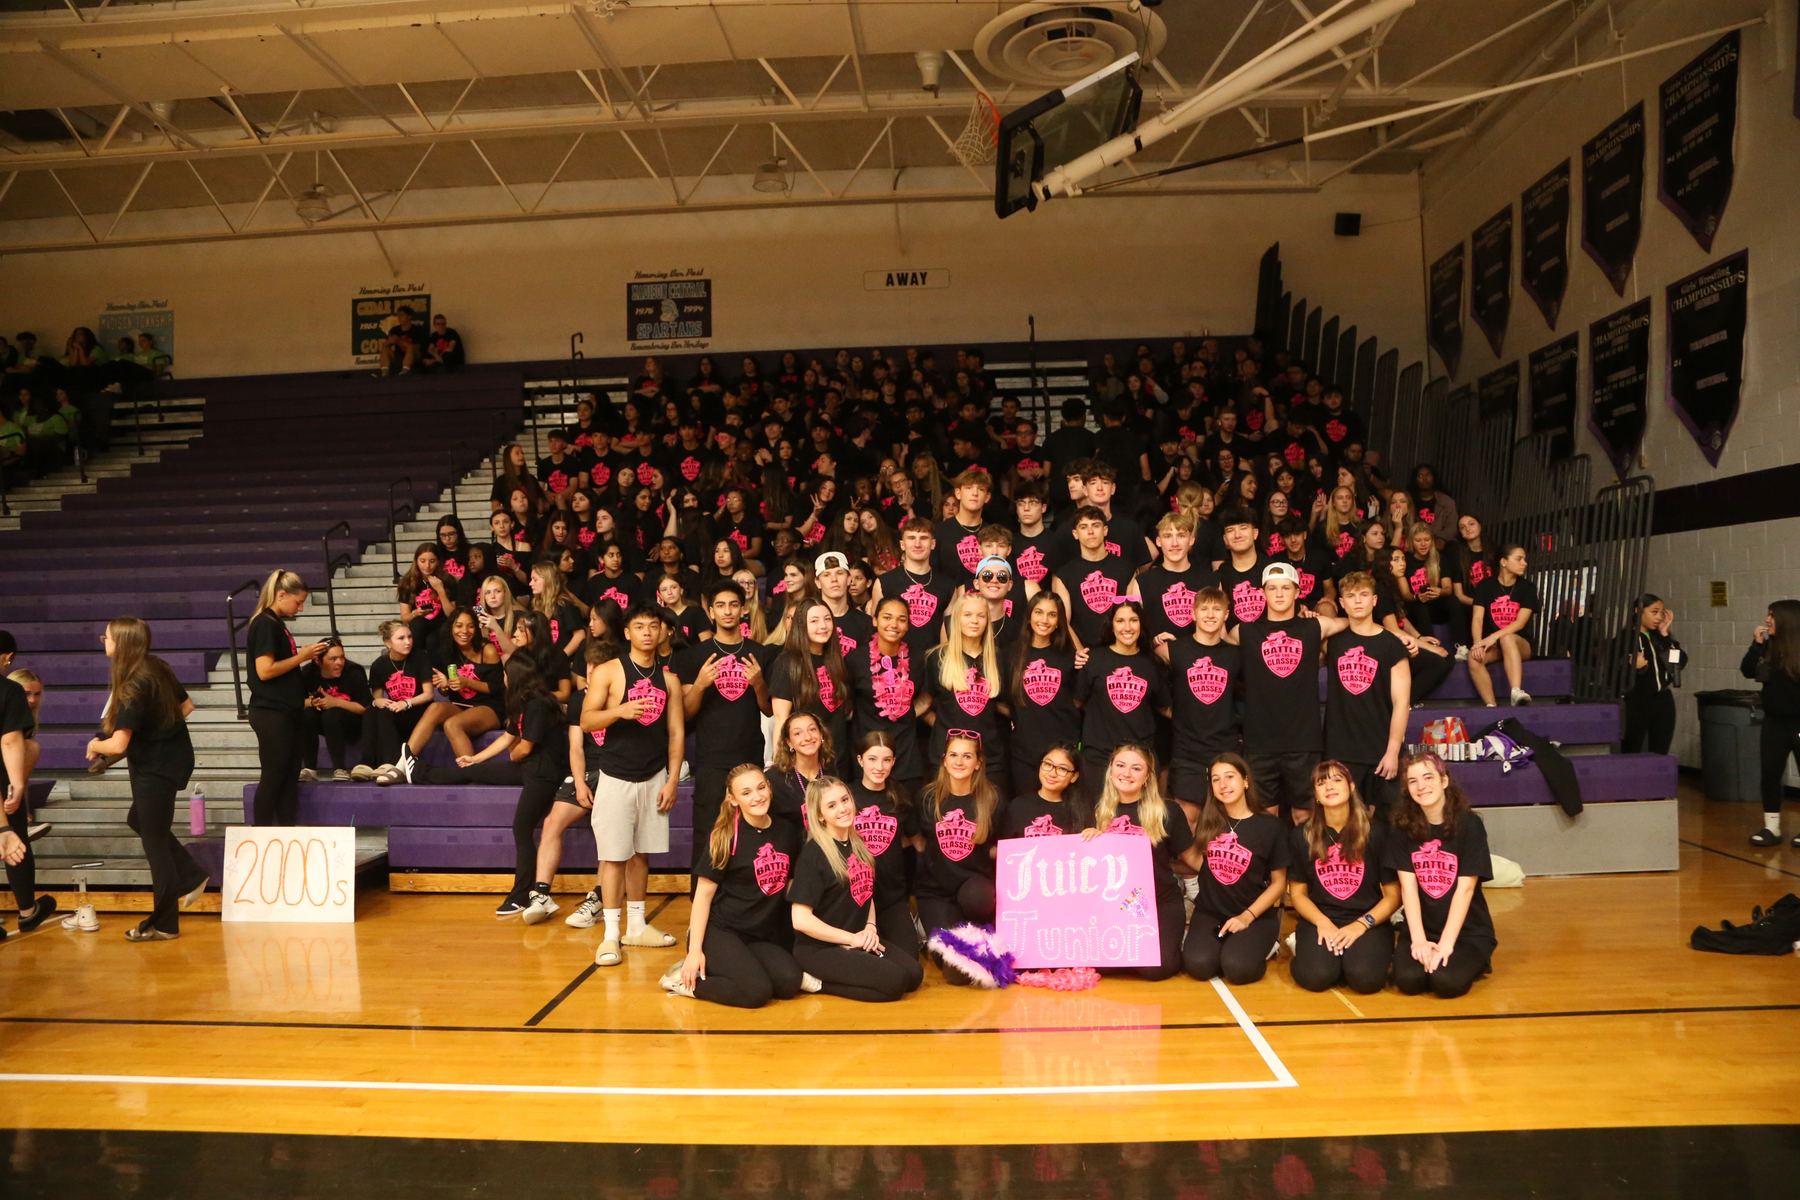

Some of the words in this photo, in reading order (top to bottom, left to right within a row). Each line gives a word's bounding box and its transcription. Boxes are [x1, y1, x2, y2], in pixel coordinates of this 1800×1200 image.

[885, 271, 928, 287] AWAY
[1672, 270, 1746, 312] CHAMPIONSHIPS
[636, 320, 703, 339] SPARTANS
[1083, 586, 1116, 595] BATTLE
[910, 598, 936, 608] ATTLE
[1164, 598, 1192, 607] BATTL
[1234, 595, 1264, 605] ATTLE
[910, 609, 932, 619] LASSES
[1168, 608, 1192, 616] CLASSE
[1235, 605, 1263, 615] CLASSES
[1263, 646, 1302, 655] BATTLE
[1267, 658, 1298, 666] CLASSES
[1339, 663, 1374, 673] BATTLE
[1024, 675, 1060, 685] BATTLE
[1190, 674, 1225, 682] BATTLE
[1341, 675, 1371, 684] CLASSES
[1028, 687, 1056, 695] CLASSES
[1108, 683, 1145, 691] BATTLE
[959, 696, 986, 704] CLASSES
[1111, 694, 1141, 702] CLASSES
[855, 822, 896, 832] BATTLE
[863, 835, 890, 844] LASSES
[940, 841, 973, 850] CLASSES
[1208, 850, 1249, 865] BATTLE
[1210, 863, 1242, 875] CLASSES
[1318, 864, 1362, 875] BATTLE
[1414, 860, 1456, 873] BATTLE
[234, 838, 348, 906] 2000's
[1005, 844, 1129, 902] Juicy
[1323, 878, 1360, 887] CLASSES
